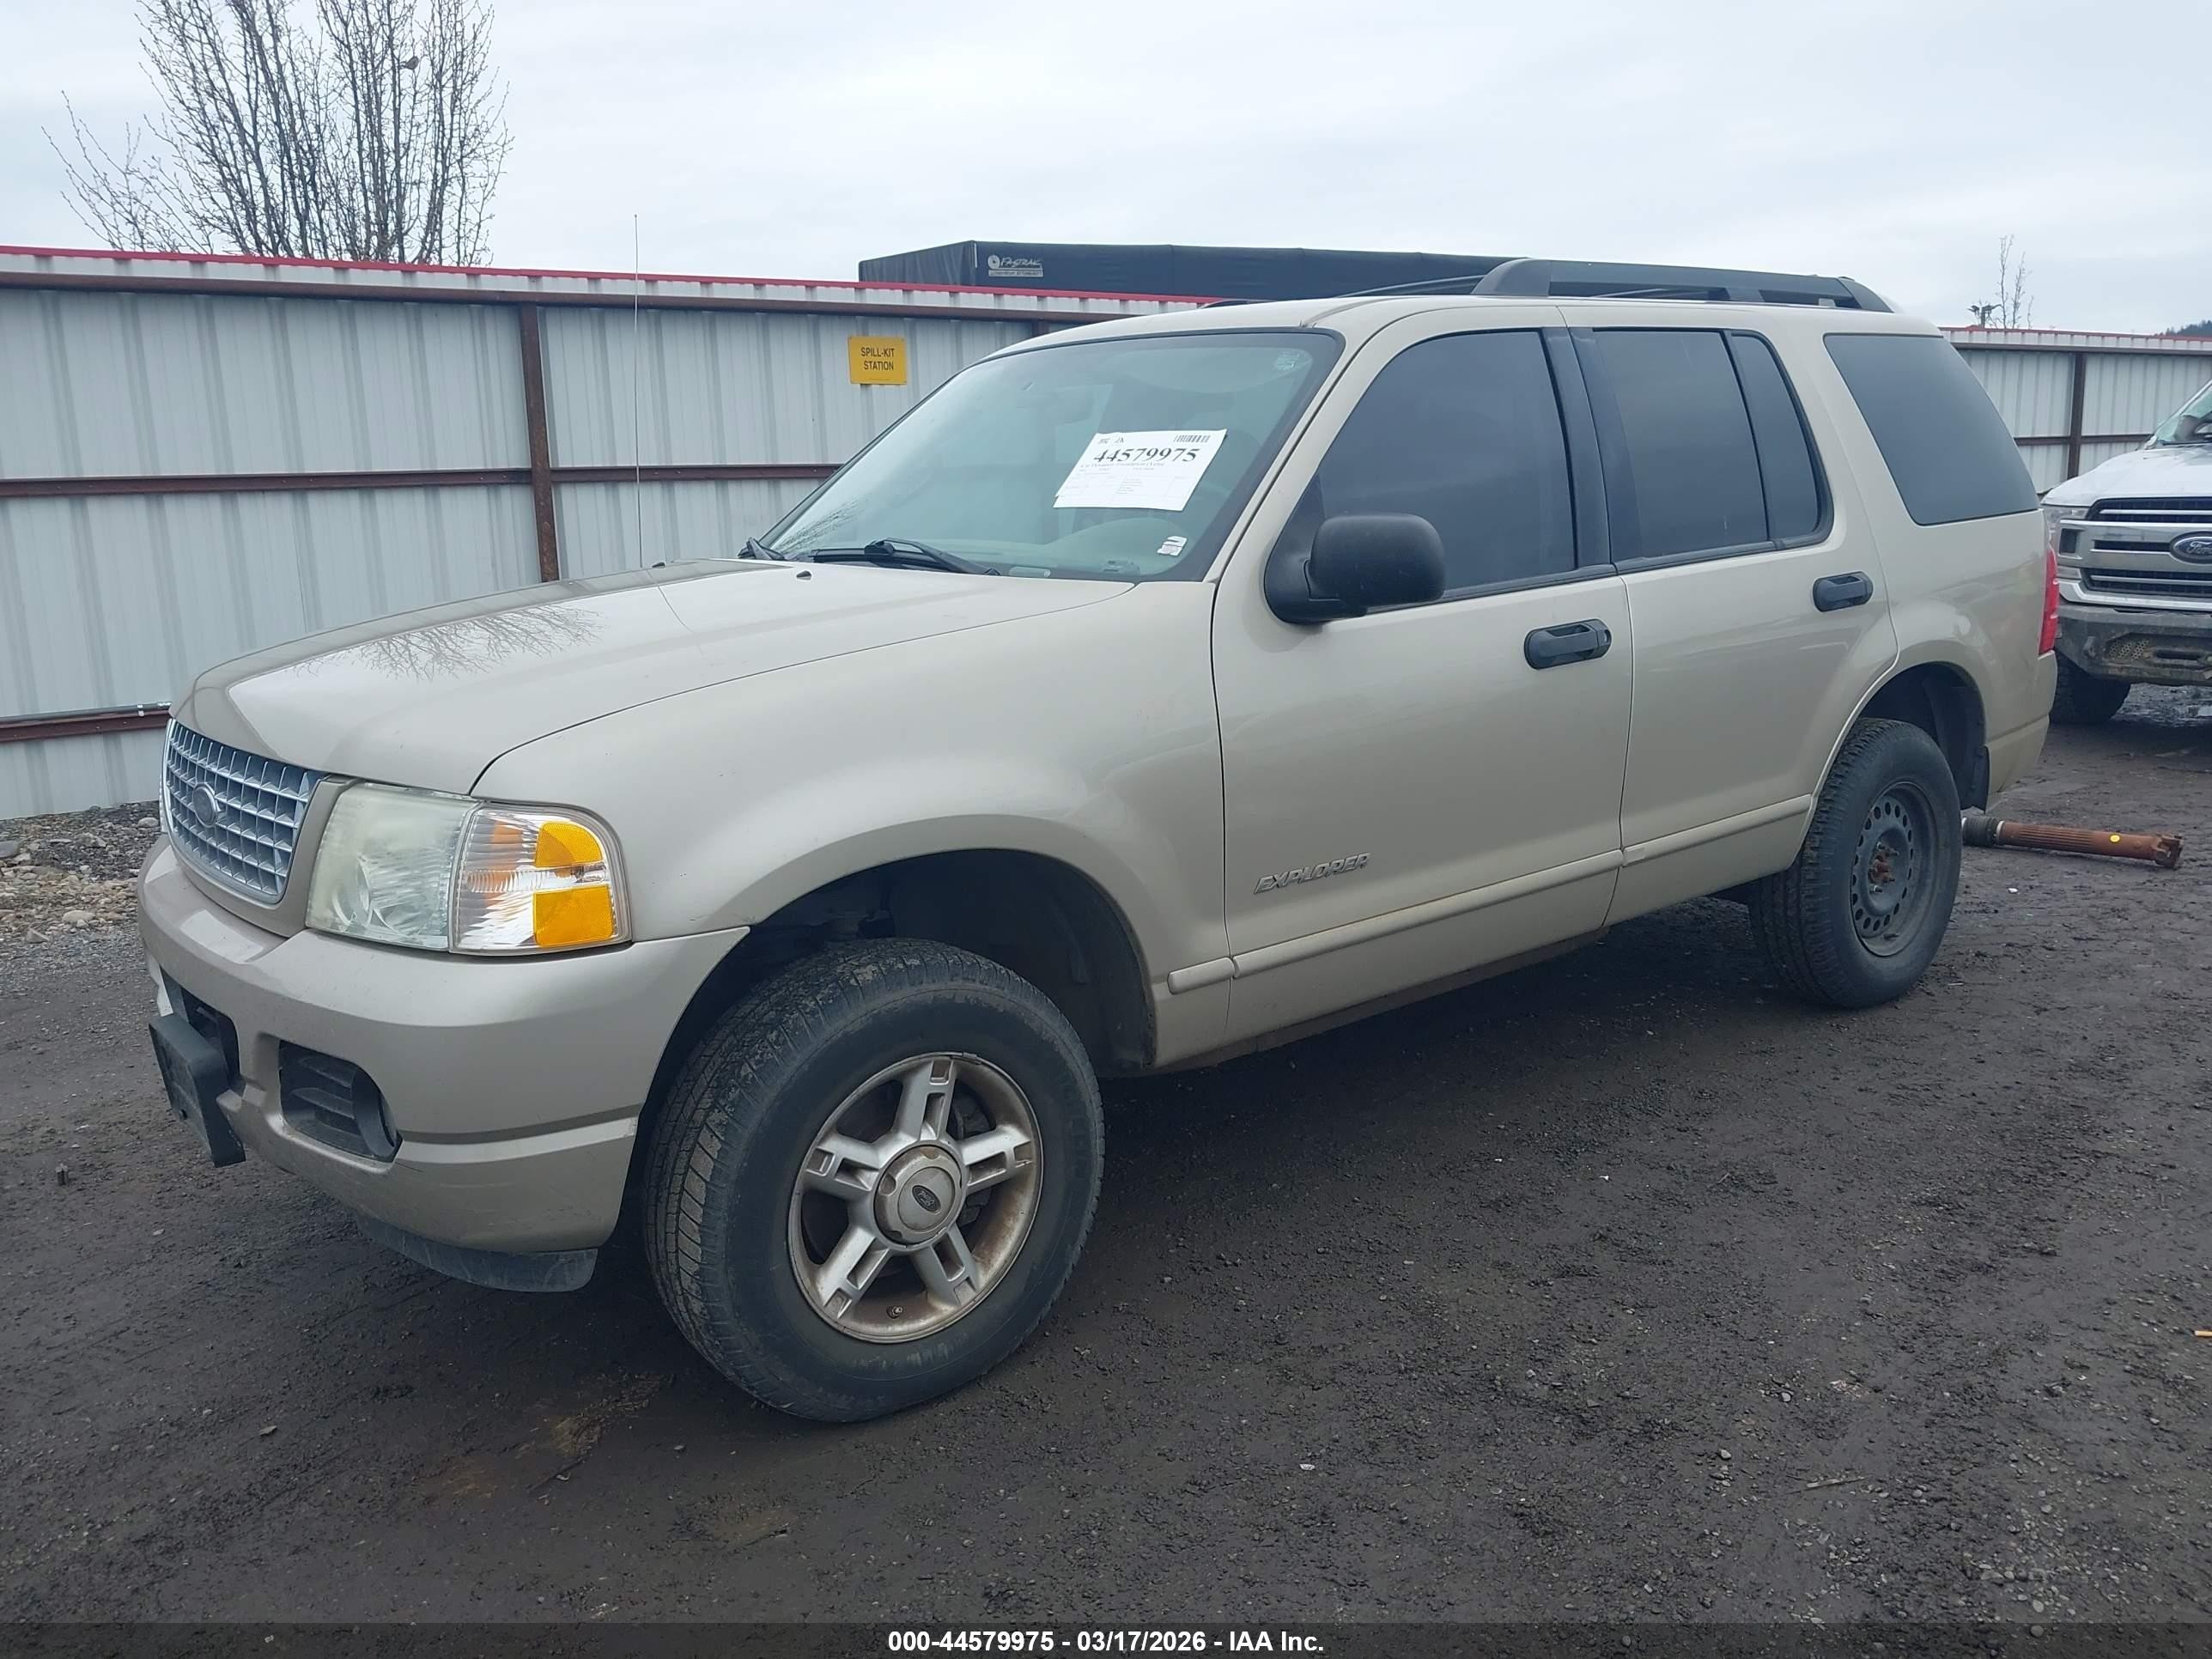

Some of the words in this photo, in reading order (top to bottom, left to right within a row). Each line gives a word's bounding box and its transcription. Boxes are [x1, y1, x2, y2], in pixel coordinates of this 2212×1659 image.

[860, 347, 895, 357] SPILL-KIT
[864, 361, 894, 370] STATION
[1093, 447, 1200, 462] 44579975
[1253, 853, 1370, 894] EXPLORER
